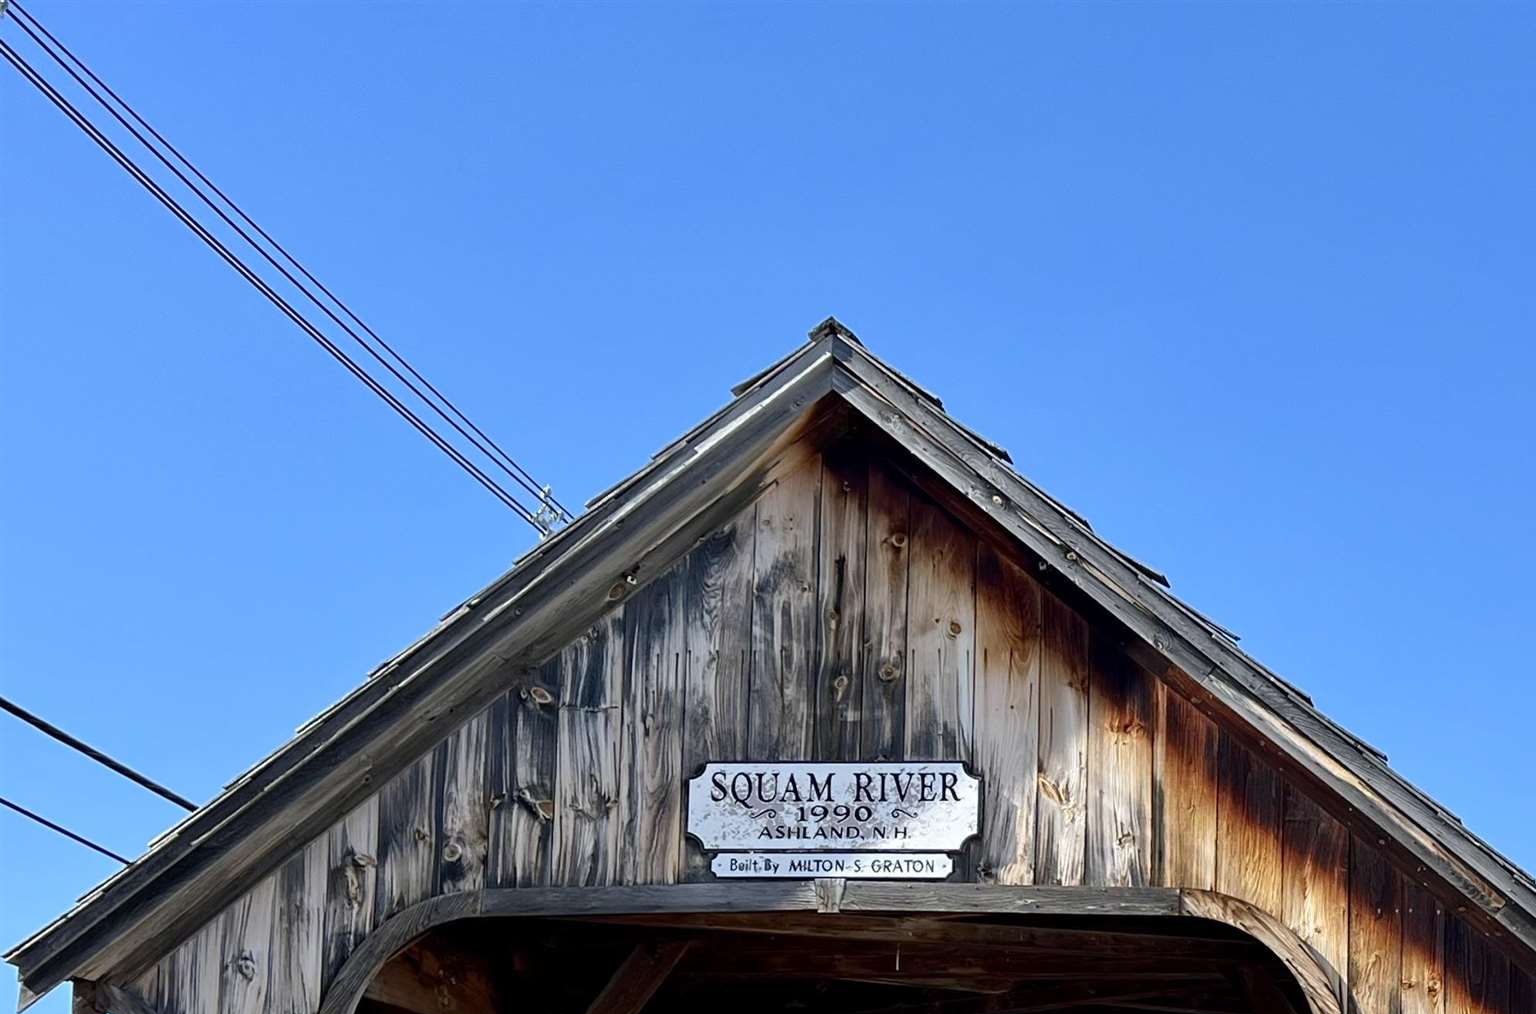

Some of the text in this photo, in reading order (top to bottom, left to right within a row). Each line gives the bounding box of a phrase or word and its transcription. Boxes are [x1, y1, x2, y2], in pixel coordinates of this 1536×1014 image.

[710, 771, 961, 809] SQUAM RIVER
[795, 804, 873, 823] 1990
[758, 826, 865, 840] ASHLAND,
[764, 858, 779, 874] By
[789, 859, 845, 872] MILTON
[871, 859, 935, 873] GRATON
